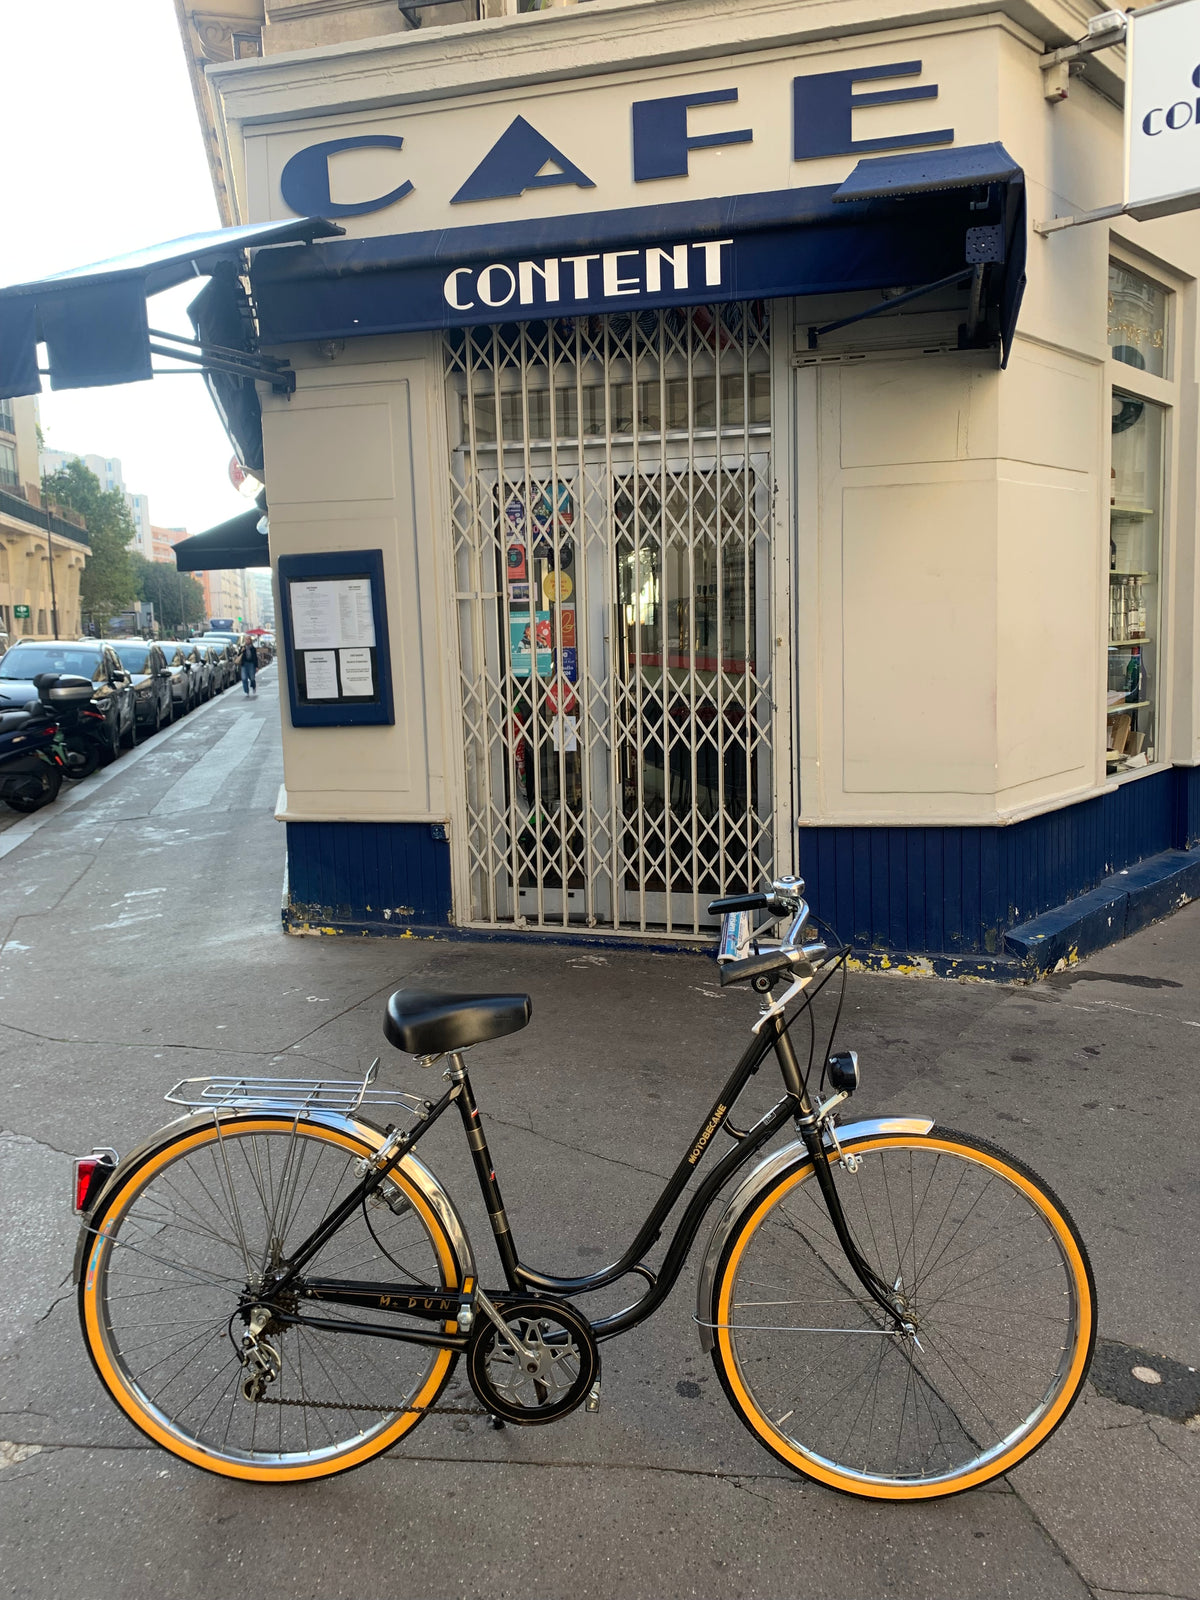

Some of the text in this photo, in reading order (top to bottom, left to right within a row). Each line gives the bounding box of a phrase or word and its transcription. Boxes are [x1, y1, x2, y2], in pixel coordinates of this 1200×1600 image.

[280, 60, 954, 219] CAFE
[1142, 97, 1200, 136] CO
[443, 239, 734, 310] CONTENT
[688, 1103, 727, 1165] MOTOBECANE
